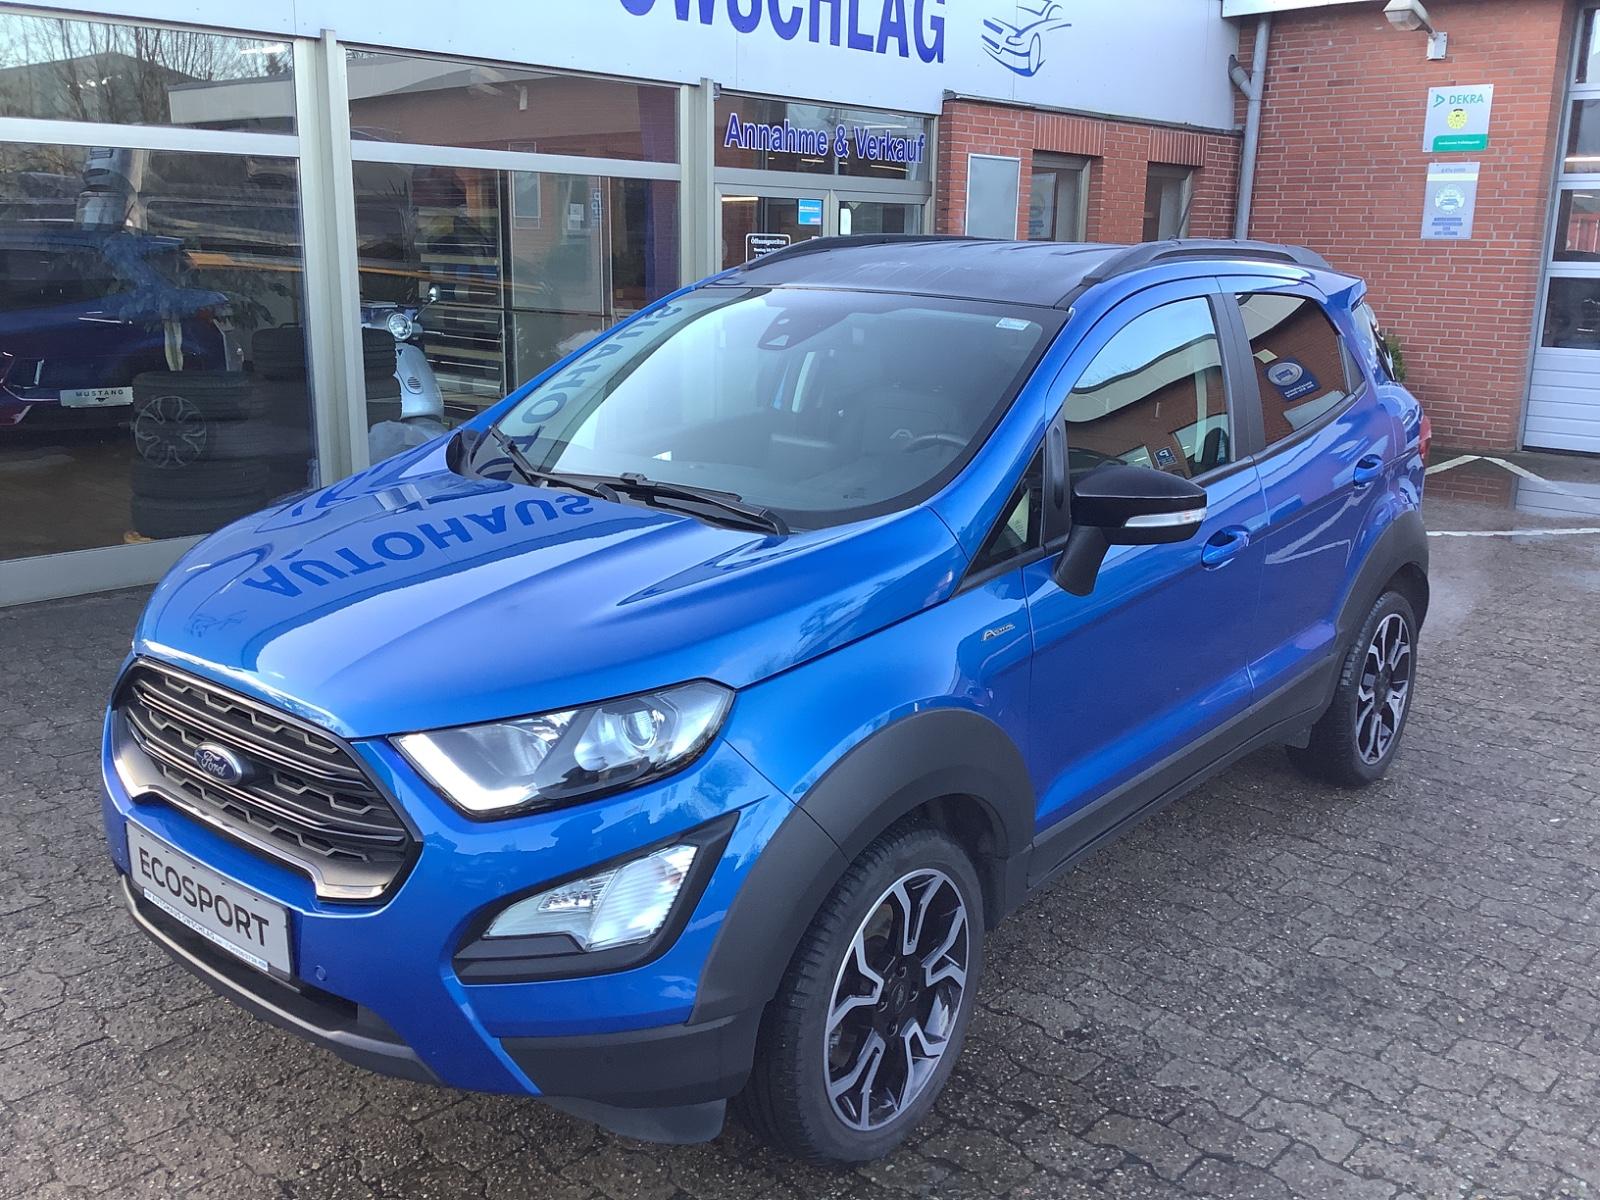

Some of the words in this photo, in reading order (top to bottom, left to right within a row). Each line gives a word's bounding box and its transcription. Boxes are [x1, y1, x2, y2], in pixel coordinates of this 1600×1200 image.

[619, 0, 945, 64] CHLAG
[1449, 93, 1484, 105] DEKRA
[724, 112, 829, 156] Annahme
[834, 124, 849, 158] &
[854, 126, 926, 163] Verkauf
[75, 389, 124, 397] MUSTANG
[201, 750, 227, 777] Ford
[139, 847, 269, 947] ECOSPORT
